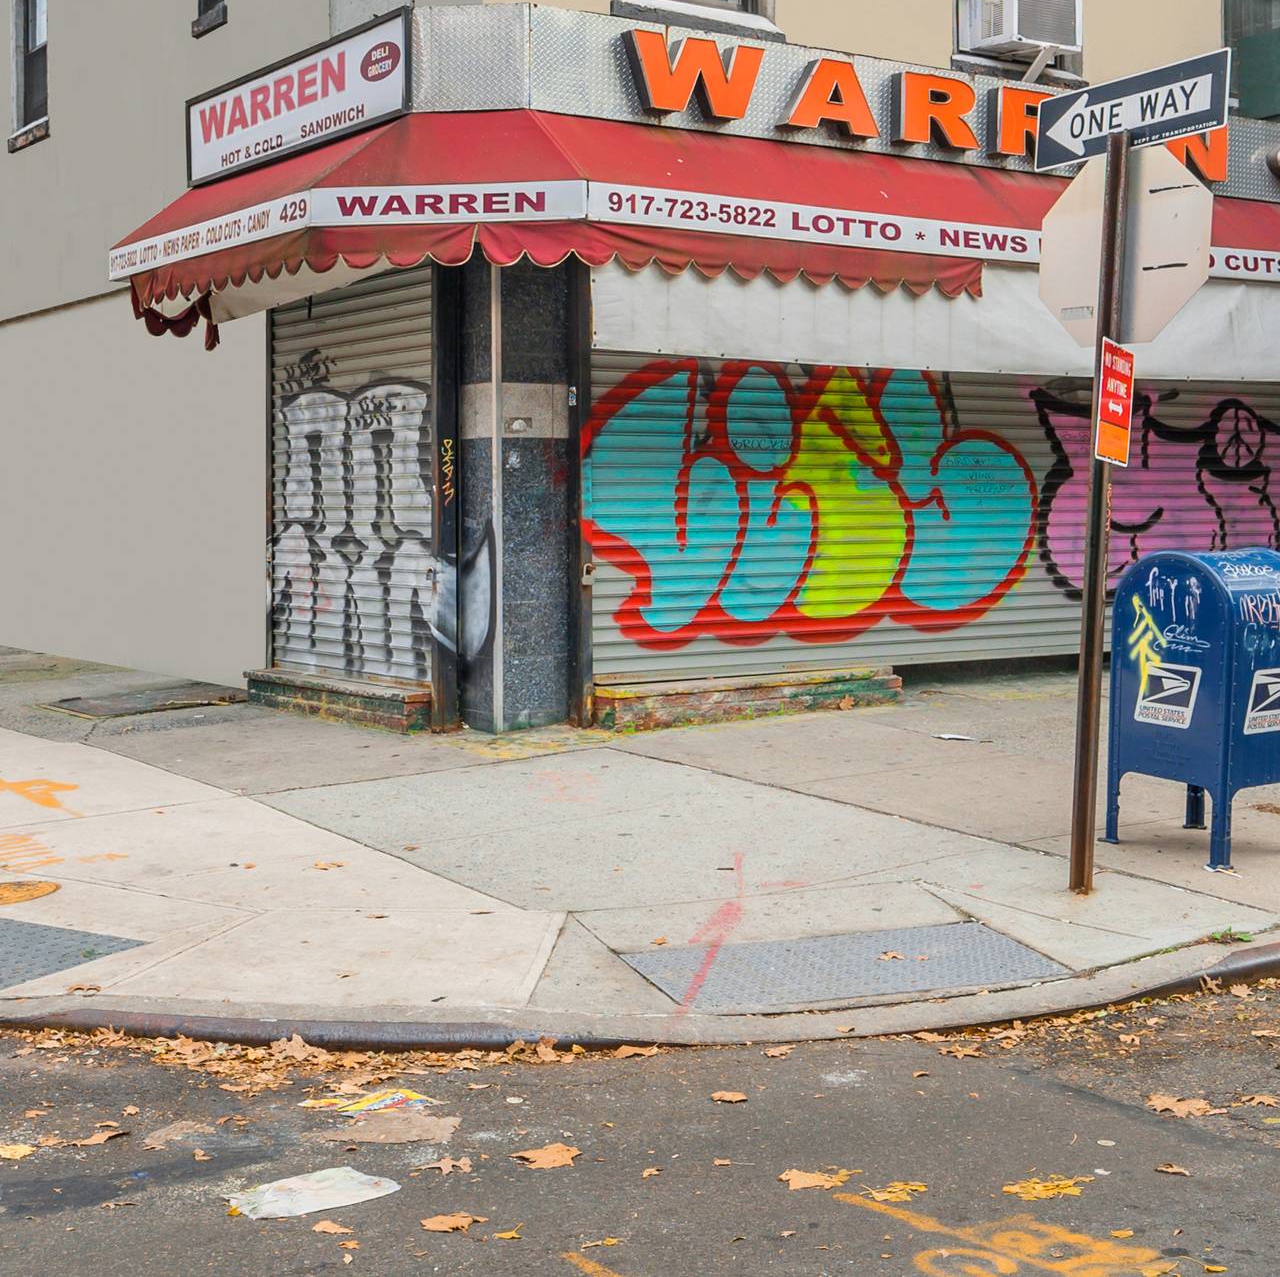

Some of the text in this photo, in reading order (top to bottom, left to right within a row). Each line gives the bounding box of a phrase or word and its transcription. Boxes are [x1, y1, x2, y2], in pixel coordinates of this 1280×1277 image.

[371, 45, 389, 61] DELI
[367, 58, 393, 78] GROCERY
[199, 50, 346, 144] WARREN
[1070, 81, 1198, 139] ONE WAY
[221, 104, 365, 167] HOT & COLD SANDWICH
[1134, 136, 1150, 145] DEPT
[1162, 120, 1217, 139] TRANSPORTATION
[336, 191, 546, 217] WARREN
[139, 243, 158, 265] LOTTO
[162, 238, 180, 259] NEWS
[181, 231, 200, 252] PAPER
[205, 225, 222, 246] COLD
[223, 220, 241, 242] CUTS
[247, 209, 271, 234] CANDY
[279, 198, 307, 223] 429
[607, 191, 777, 228] 917-723-5822
[791, 211, 902, 242] LOTTO
[939, 228, 1028, 254] NEWS
[1105, 351, 1132, 378] NO STANDING
[1106, 377, 1128, 399] ANYTIME
[1137, 712, 1186, 725] POSTAL SERVICE
[1139, 705, 1185, 717] UNITED STATES
[1247, 722, 1266, 731] POSTAL
